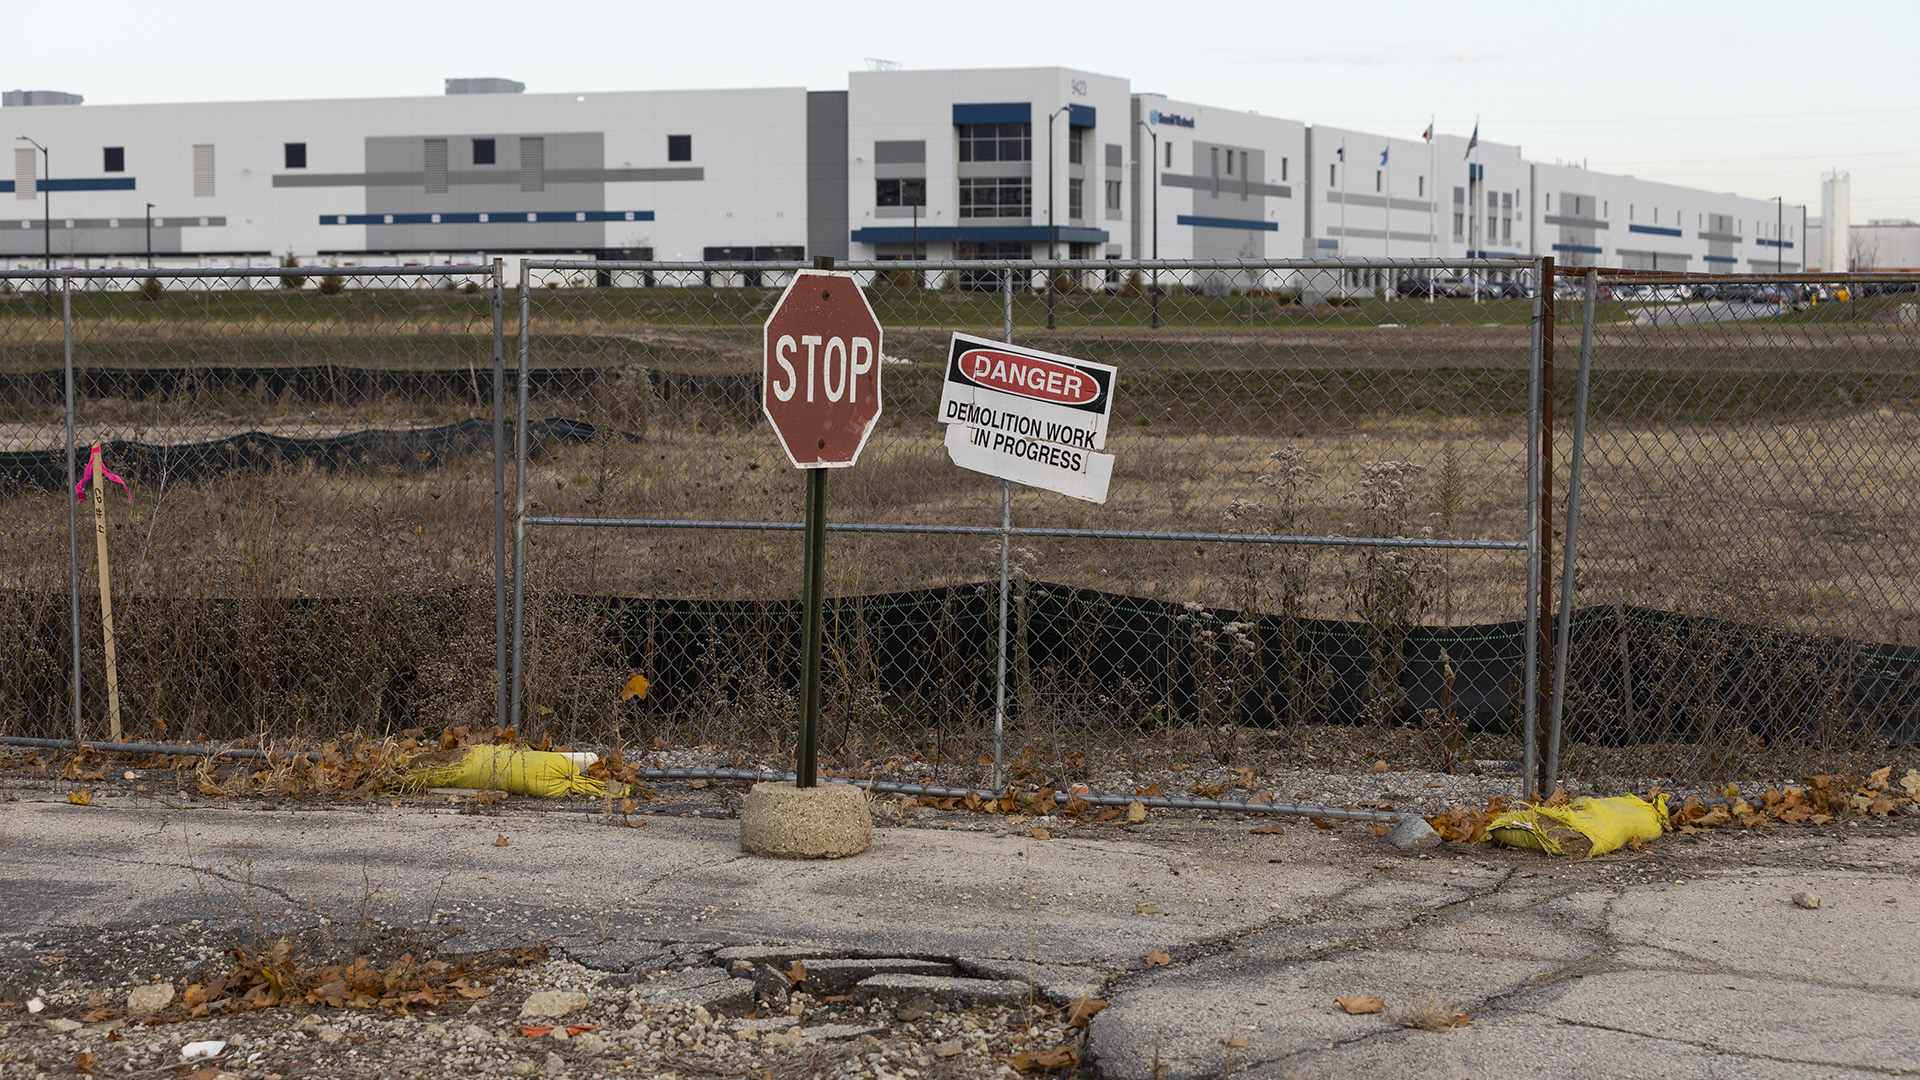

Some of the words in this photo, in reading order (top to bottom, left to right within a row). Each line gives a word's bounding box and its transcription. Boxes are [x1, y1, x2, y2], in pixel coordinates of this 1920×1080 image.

[1071, 79, 1087, 96] 9423
[773, 334, 873, 403] STOP
[973, 355, 1083, 398] DANGER
[946, 399, 1042, 438] DEMOLITION
[1047, 421, 1097, 449] WORK
[973, 427, 991, 448] IN
[993, 432, 1082, 472] PROGRESS
[95, 487, 102, 503] CP
